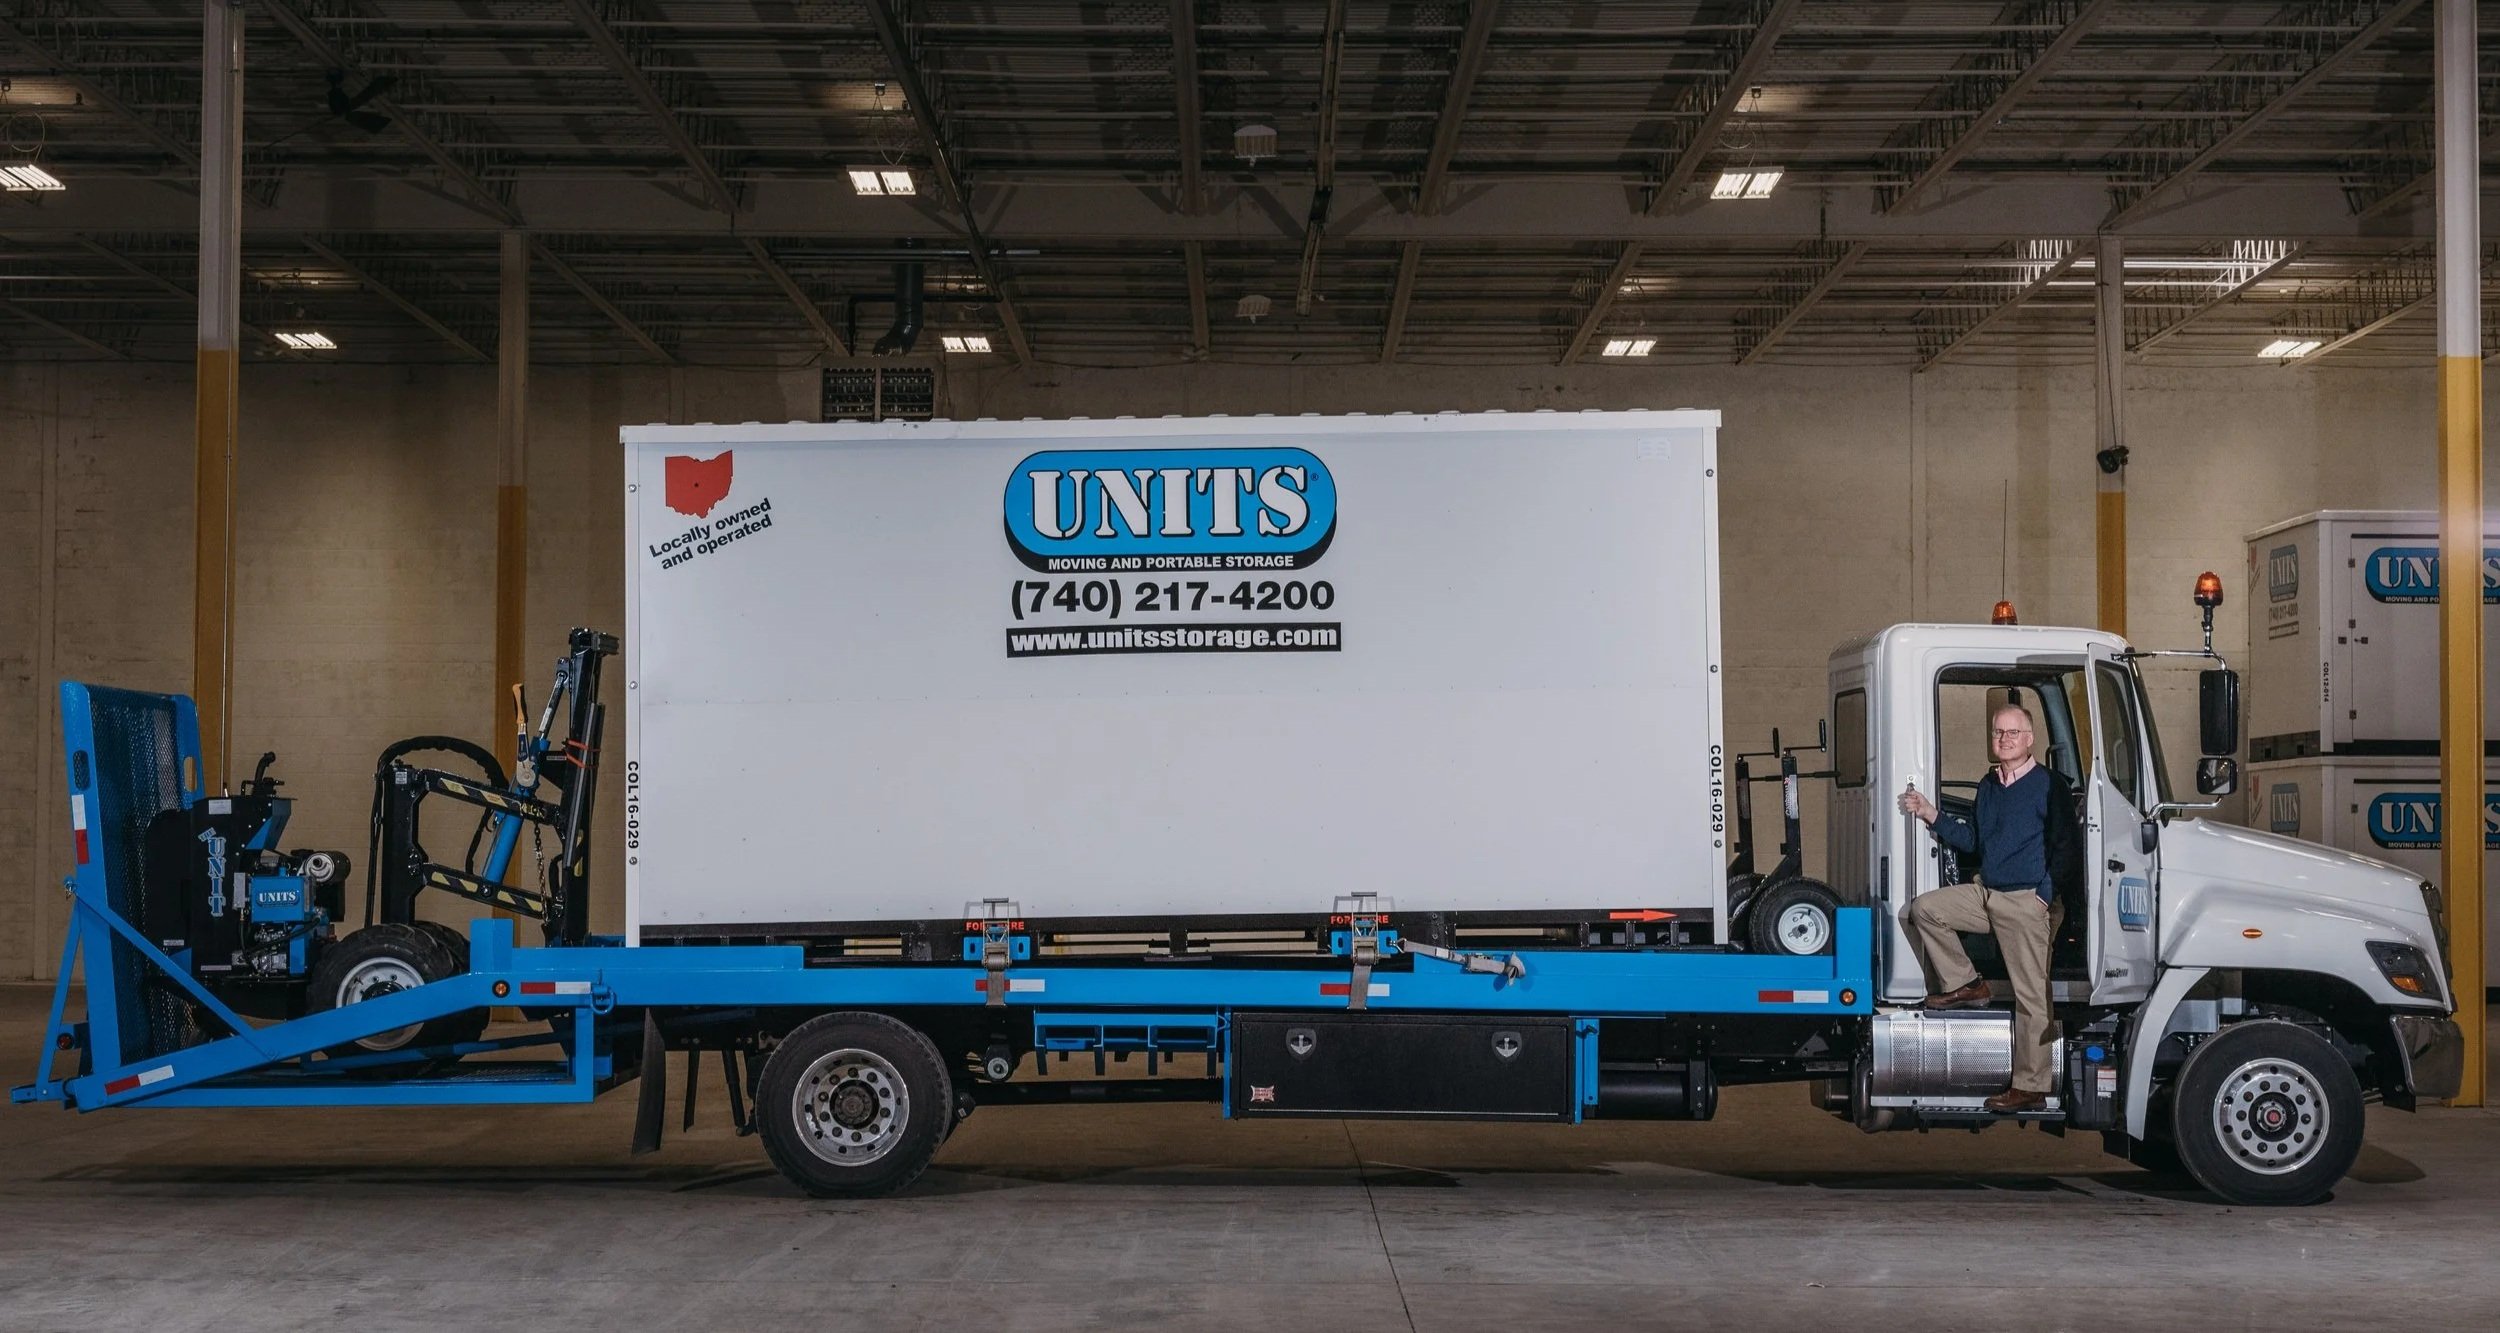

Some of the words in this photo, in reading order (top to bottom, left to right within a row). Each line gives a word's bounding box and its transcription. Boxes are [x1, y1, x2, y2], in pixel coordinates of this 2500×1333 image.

[1028, 465, 1308, 539] UNITS
[649, 525, 711, 558] Locally
[715, 497, 771, 530] owned
[661, 546, 694, 570] and
[697, 514, 773, 554] operated
[1049, 557, 1107, 570] MOVING
[1111, 557, 1141, 569] AND
[1146, 556, 1221, 569] PORTABLE
[1226, 555, 1294, 568] STORAGE
[2378, 556, 2500, 588] UNS
[1011, 579, 1122, 620] (740)
[1135, 580, 1335, 612] 217-4200
[1011, 627, 1337, 652] www.unitsstorage.com
[628, 761, 639, 849] COL16-029
[1711, 745, 1723, 832] COL16-029
[2380, 802, 2500, 834] UNS
[208, 836, 227, 917] UNIT
[258, 891, 297, 903] UNITS
[2121, 885, 2148, 915] UNITS
